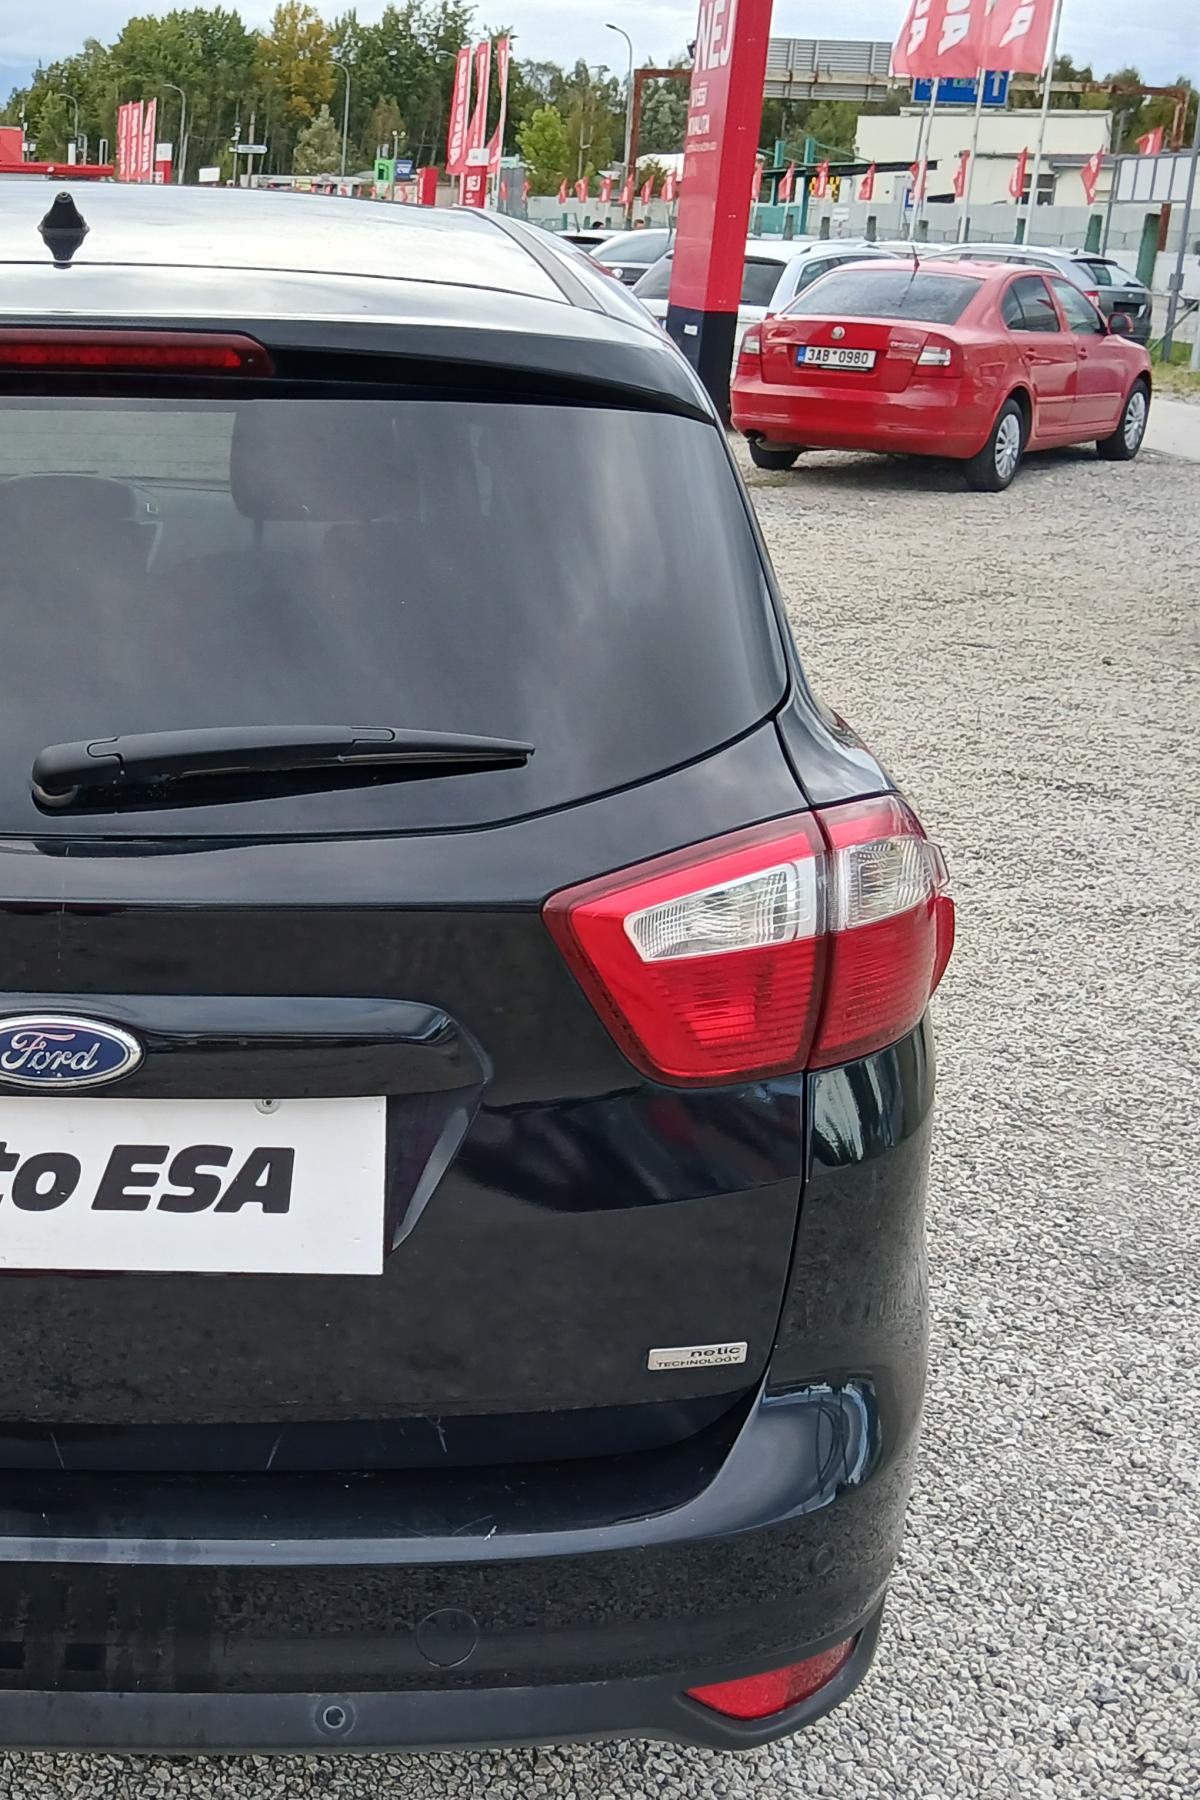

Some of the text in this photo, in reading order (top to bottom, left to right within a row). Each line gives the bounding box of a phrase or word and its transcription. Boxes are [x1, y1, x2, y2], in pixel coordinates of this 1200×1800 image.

[807, 348, 869, 364] 3AB 0980
[0, 1030, 98, 1073] Ford
[90, 1143, 295, 1214] ESA
[656, 1355, 740, 1367] TECHNOLOGY
